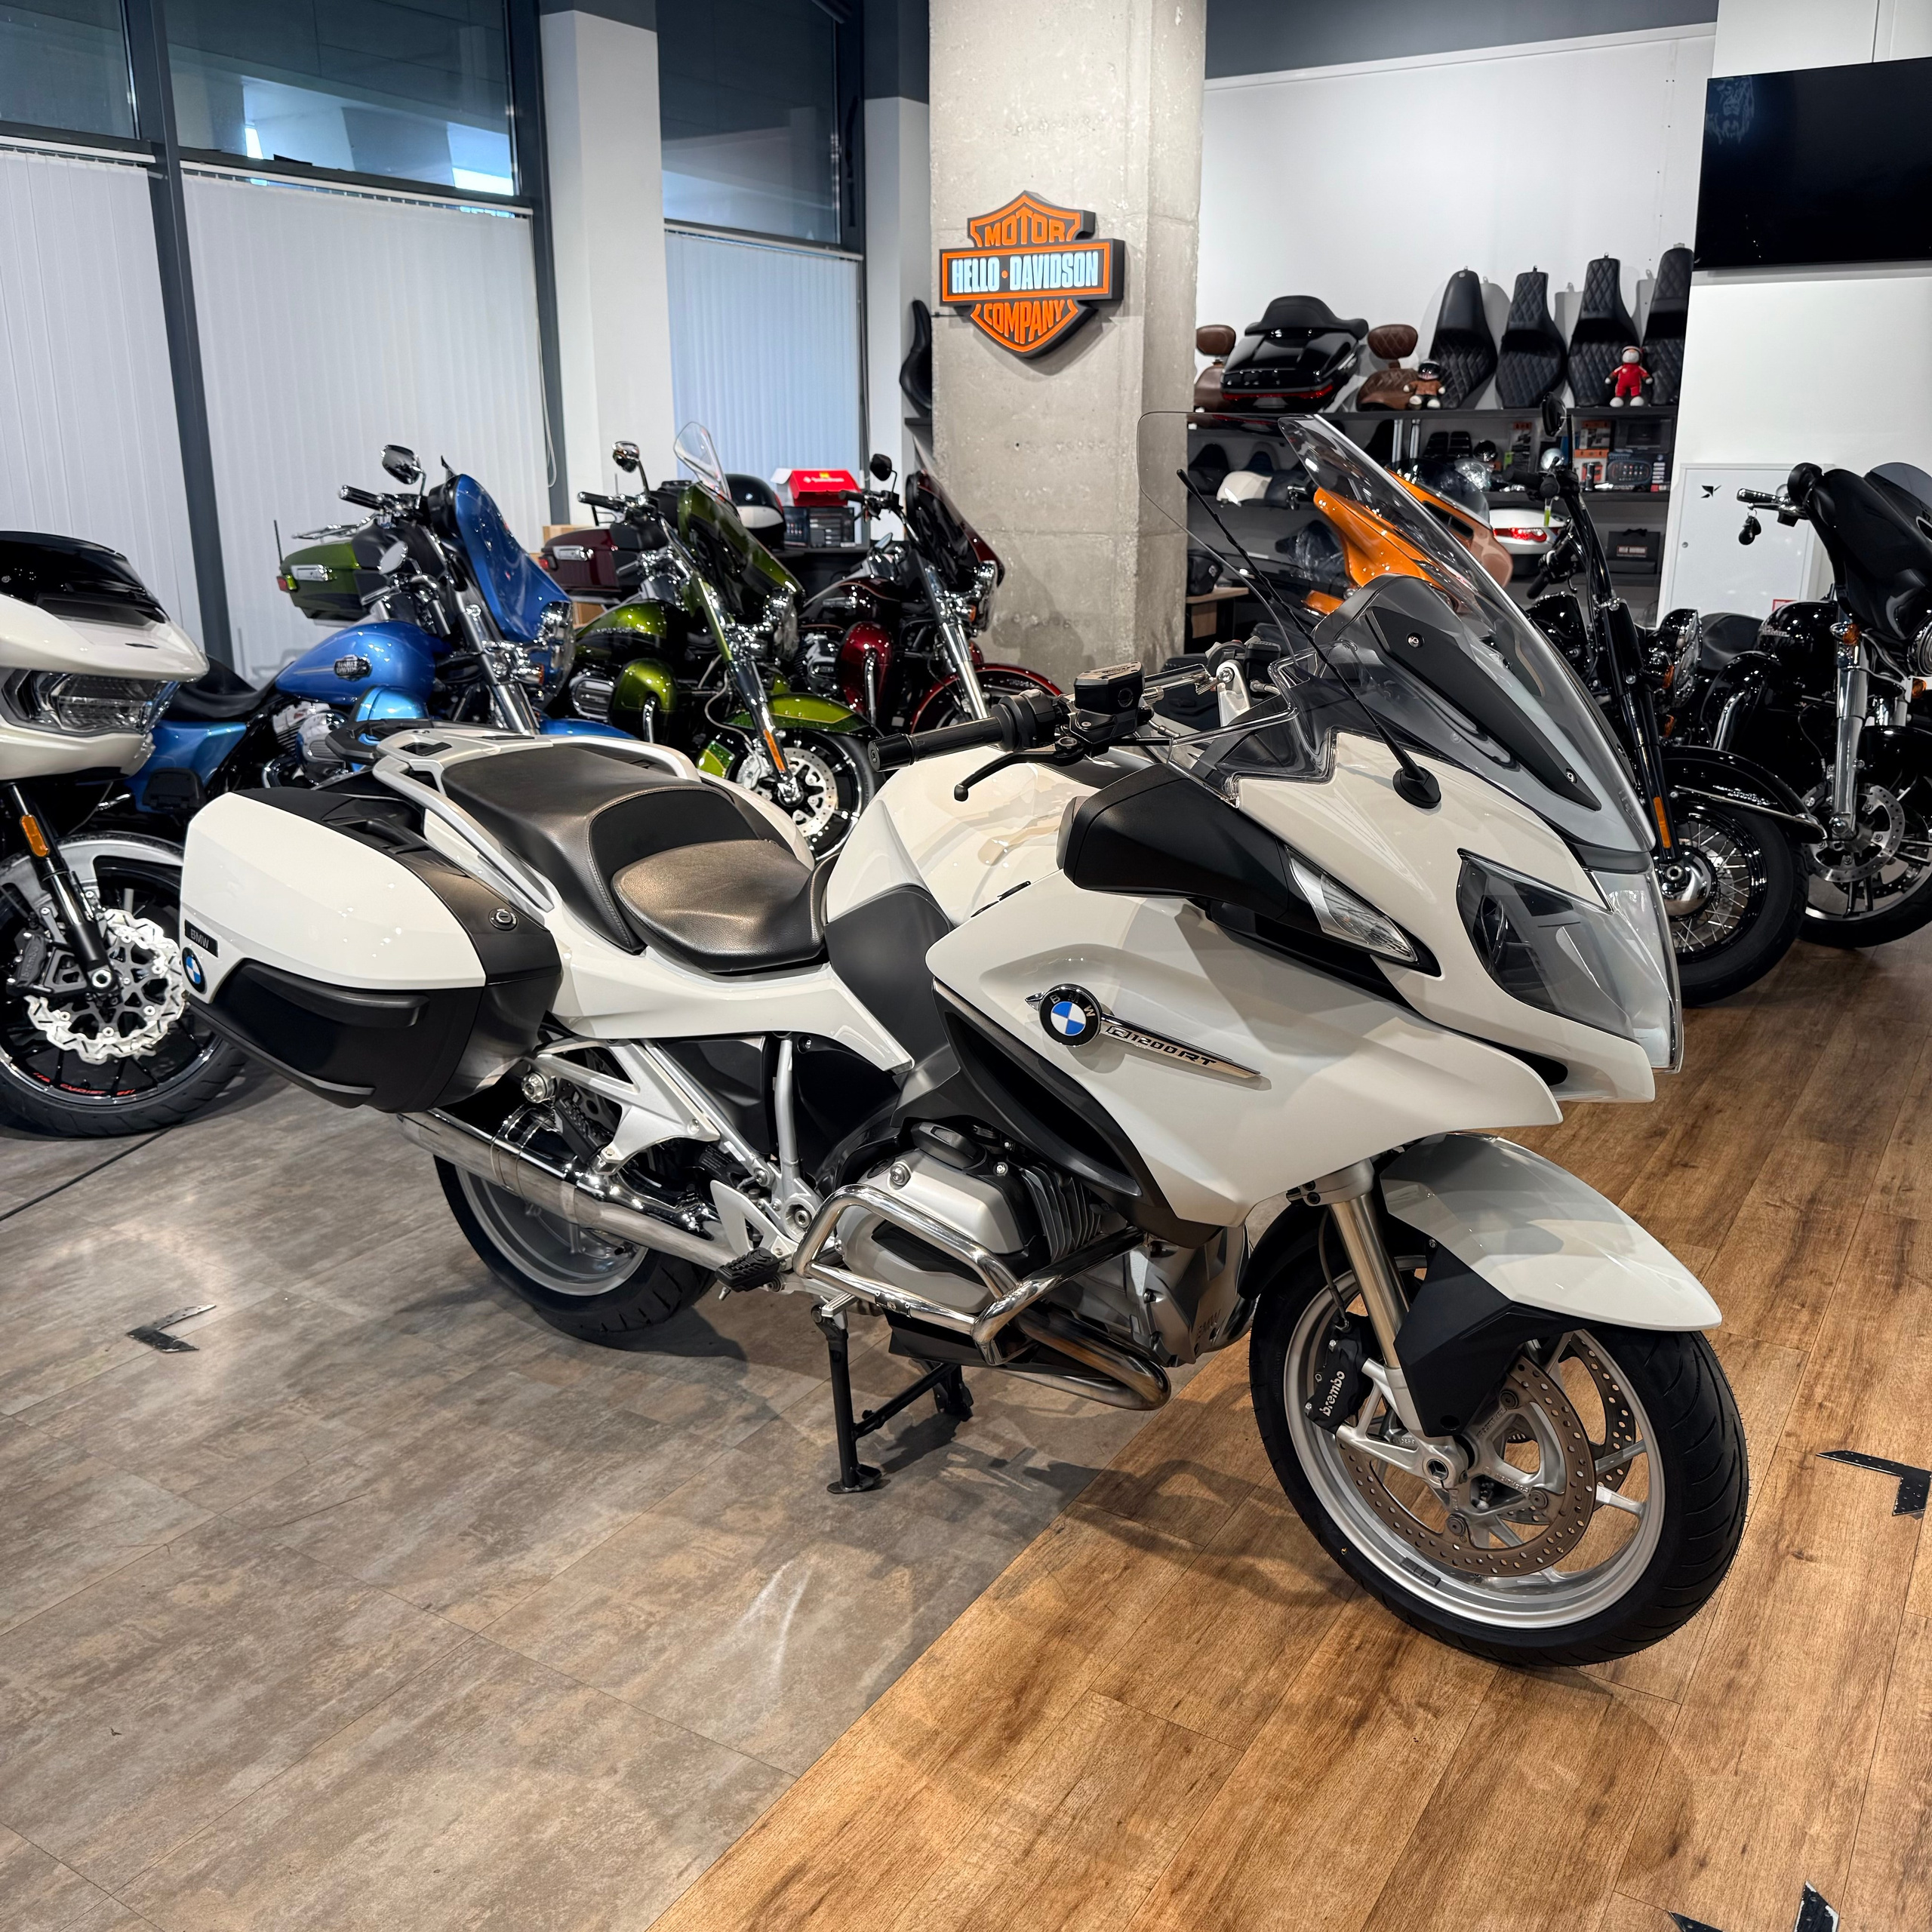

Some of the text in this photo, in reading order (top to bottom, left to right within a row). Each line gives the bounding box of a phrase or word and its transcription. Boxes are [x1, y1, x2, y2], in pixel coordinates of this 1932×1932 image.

[984, 206, 1066, 247] MOTOR
[952, 251, 1099, 294] HELLO DAVIDSON
[983, 300, 1066, 344] COMPANY
[189, 928, 210, 949] BMW
[21, 946, 38, 980] brembo
[1050, 992, 1096, 1017] BMW
[1318, 1371, 1346, 1417] brembo
